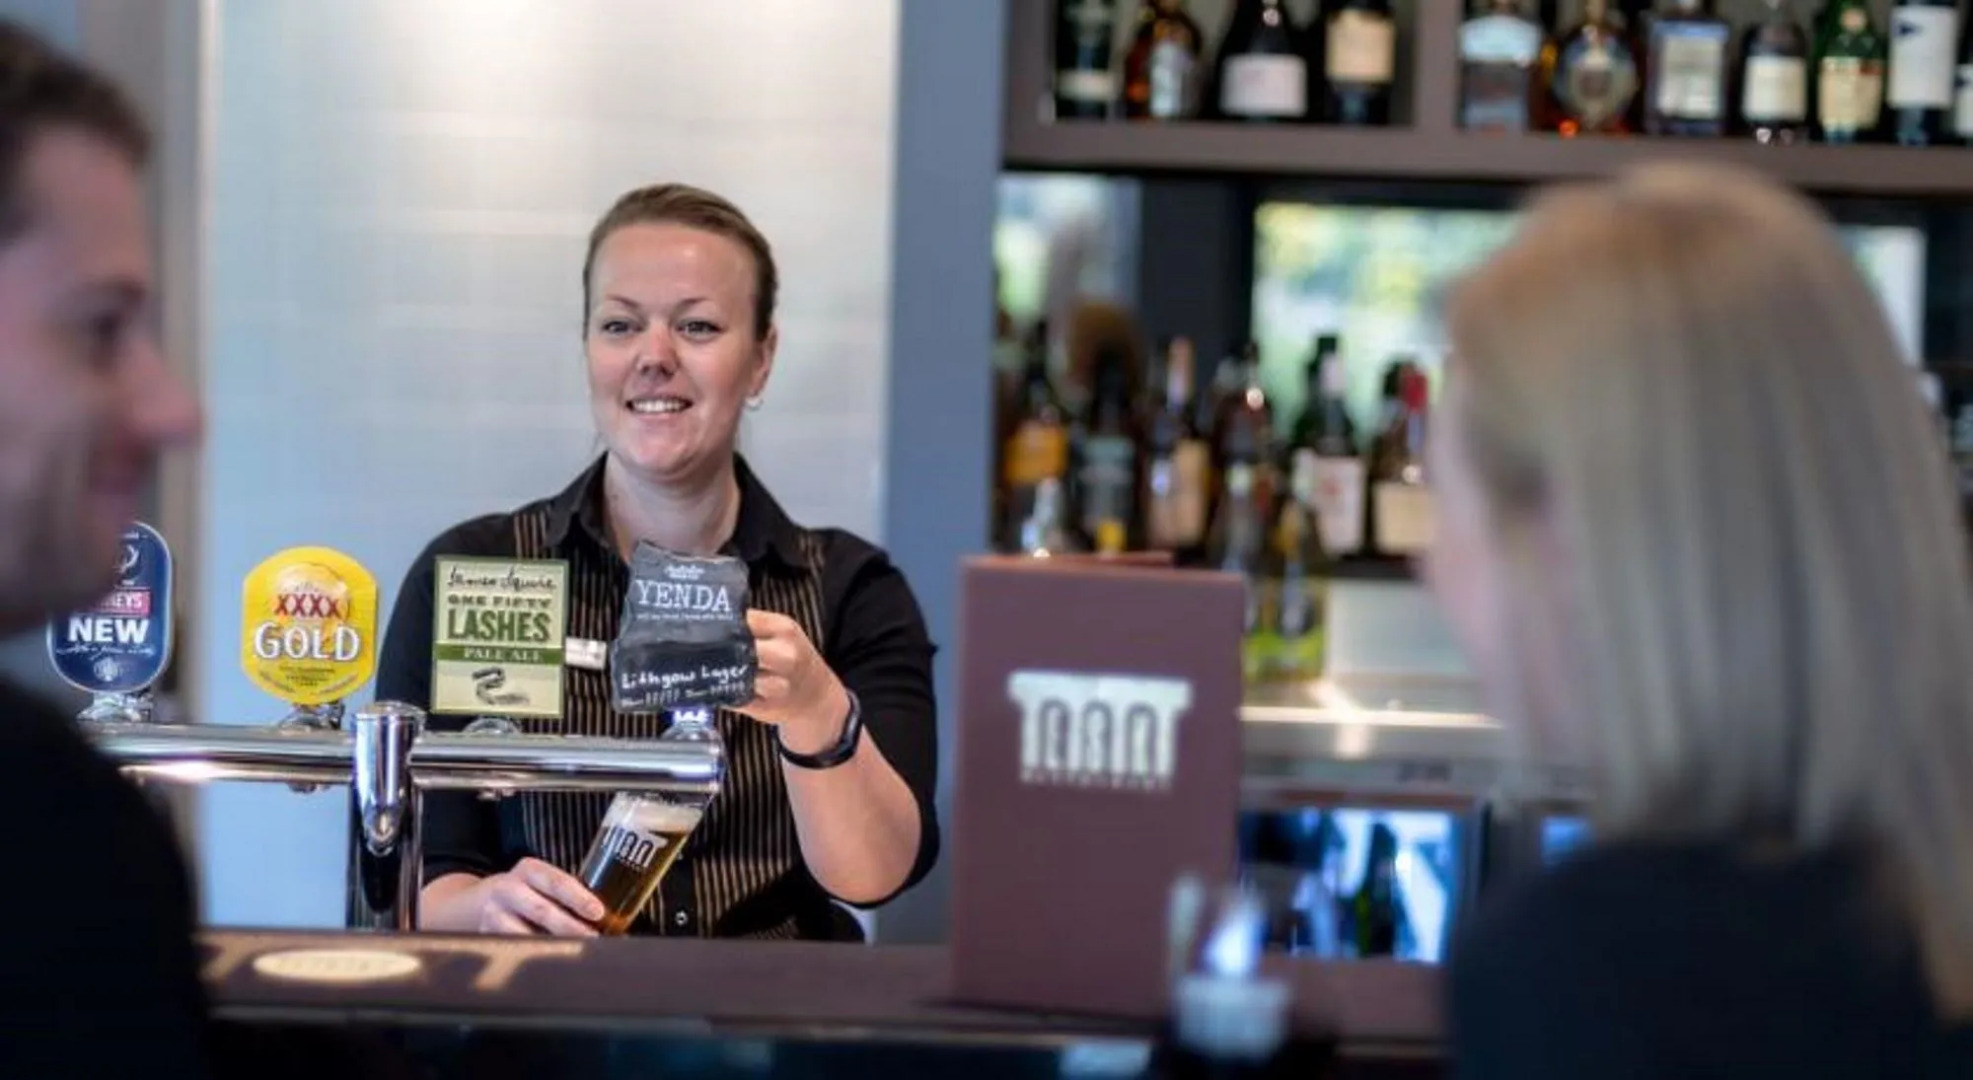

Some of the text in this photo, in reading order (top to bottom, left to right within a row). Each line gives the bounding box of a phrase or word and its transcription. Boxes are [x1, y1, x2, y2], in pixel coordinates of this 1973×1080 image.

[273, 593, 342, 619] XXXX
[448, 594, 552, 609] ONE FIFTY
[635, 578, 732, 612] YENDA
[67, 616, 151, 645] NEW
[447, 608, 551, 643] LASHES
[254, 622, 361, 661] GOLD
[464, 646, 544, 662] PALE ALE
[621, 671, 697, 689] Lithgow
[701, 663, 749, 685] Lager
